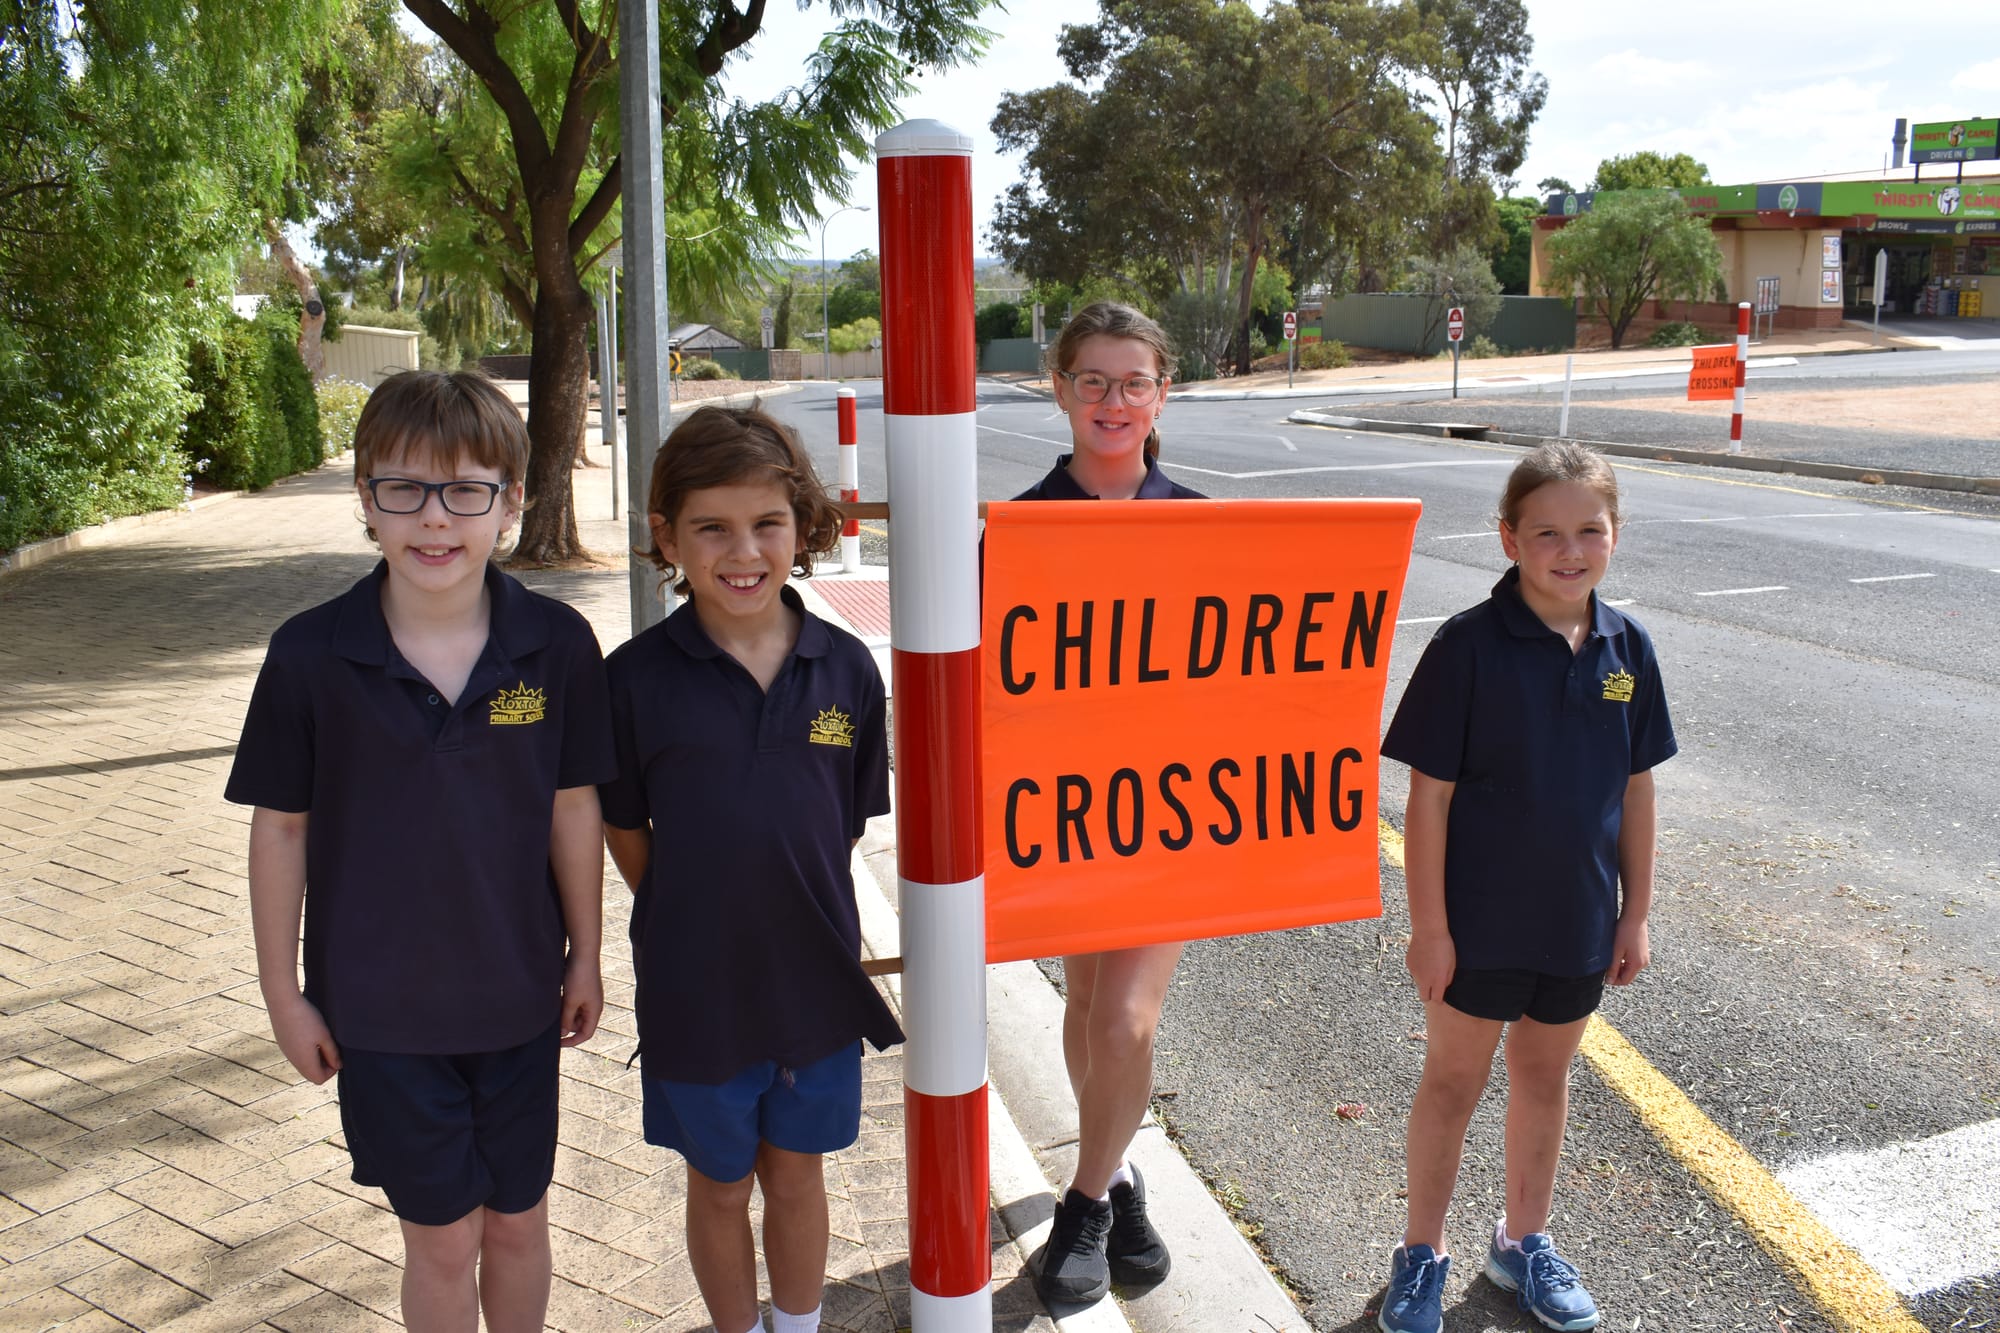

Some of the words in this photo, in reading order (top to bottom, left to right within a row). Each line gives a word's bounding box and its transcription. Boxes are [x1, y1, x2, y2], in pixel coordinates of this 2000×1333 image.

[1915, 132, 1946, 141] THIRSTY
[1967, 130, 1996, 138] CAMEL
[1930, 151, 1953, 160] DRIVE
[1954, 150, 1963, 158] IN
[1873, 193, 1934, 208] THIRSTY
[1877, 221, 1910, 231] BROWSE
[1966, 222, 1997, 231] EXPRESS
[1694, 355, 1736, 370] CHILDREN
[1690, 377, 1735, 390] CROSSING
[999, 589, 1388, 696] CHILDREN
[490, 714, 523, 723] PRIMARY
[1004, 746, 1364, 869] CROSSING
